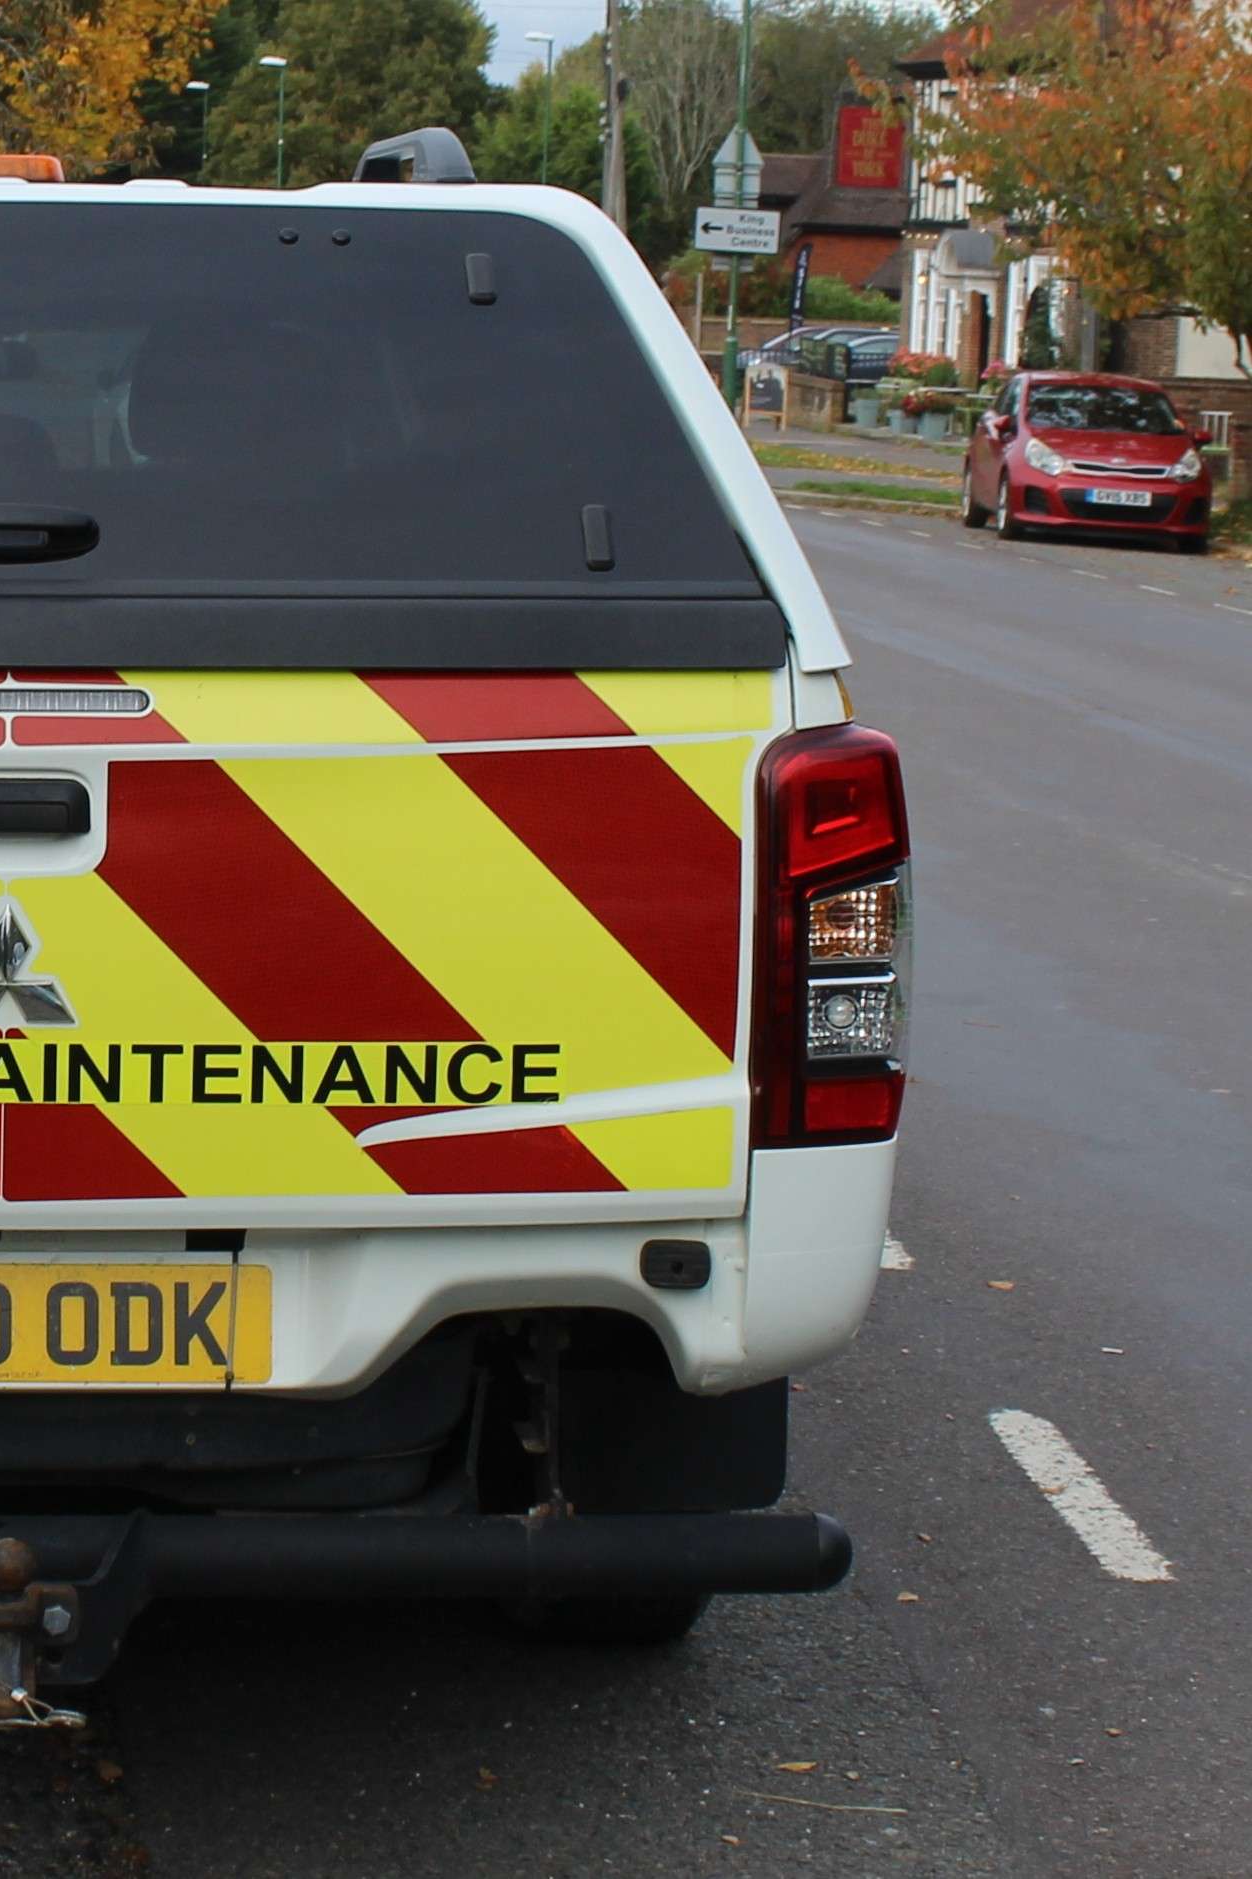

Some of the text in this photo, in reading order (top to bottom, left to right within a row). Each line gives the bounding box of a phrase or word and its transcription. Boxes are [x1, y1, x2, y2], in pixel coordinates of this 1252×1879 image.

[739, 215, 765, 225] King
[727, 224, 775, 237] Business
[731, 237, 769, 248] Centre
[46, 1281, 228, 1367] ODK
